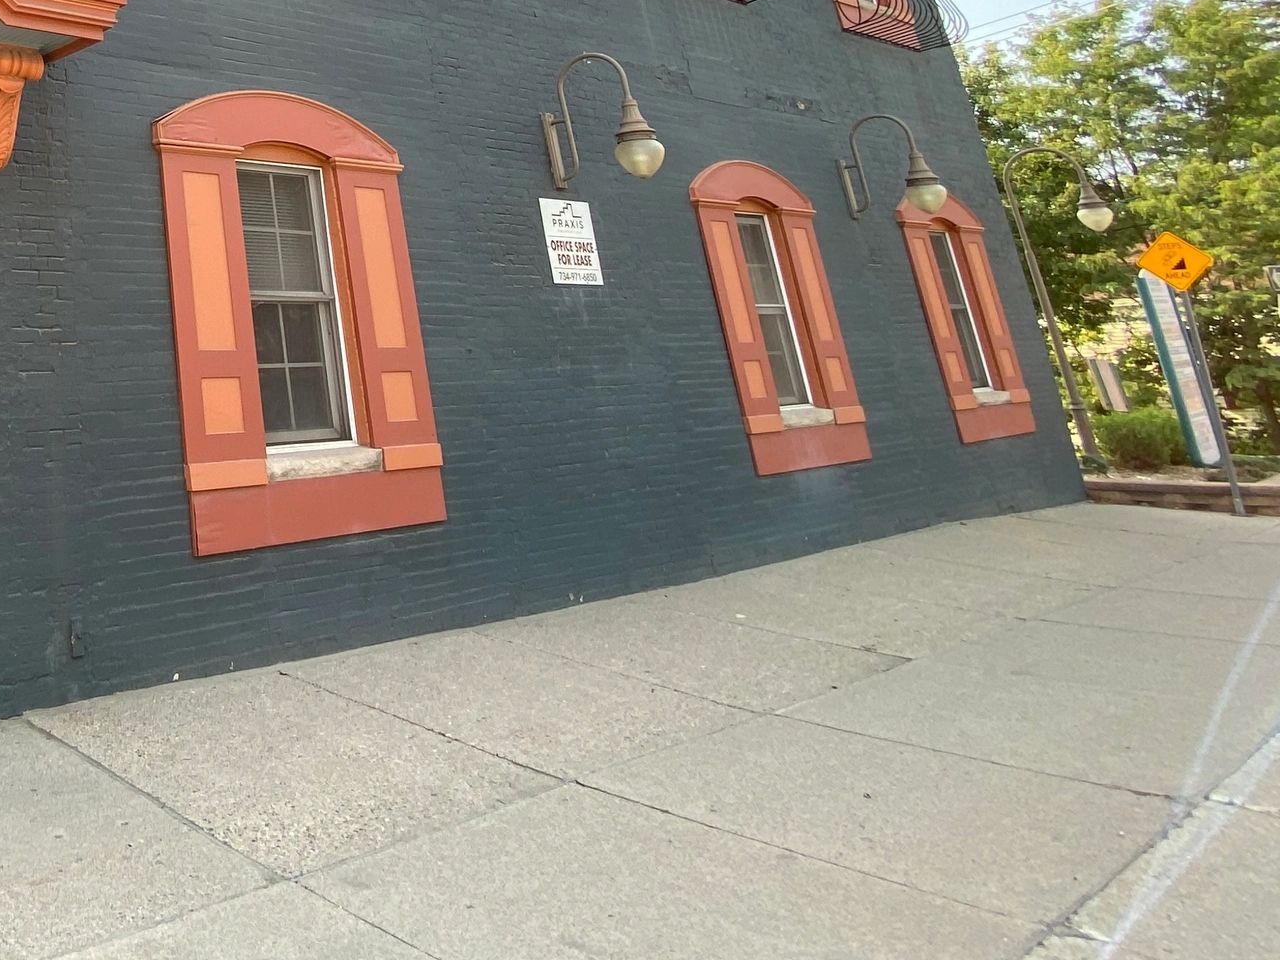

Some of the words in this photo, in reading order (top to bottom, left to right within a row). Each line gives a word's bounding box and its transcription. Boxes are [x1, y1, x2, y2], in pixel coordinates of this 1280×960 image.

[552, 218, 584, 229] PRAXIS
[551, 240, 573, 252] OFFICE
[575, 242, 594, 253] SPACE
[558, 254, 572, 265] FOR
[573, 254, 592, 266] LEASE
[1165, 271, 1191, 279] AHEAD
